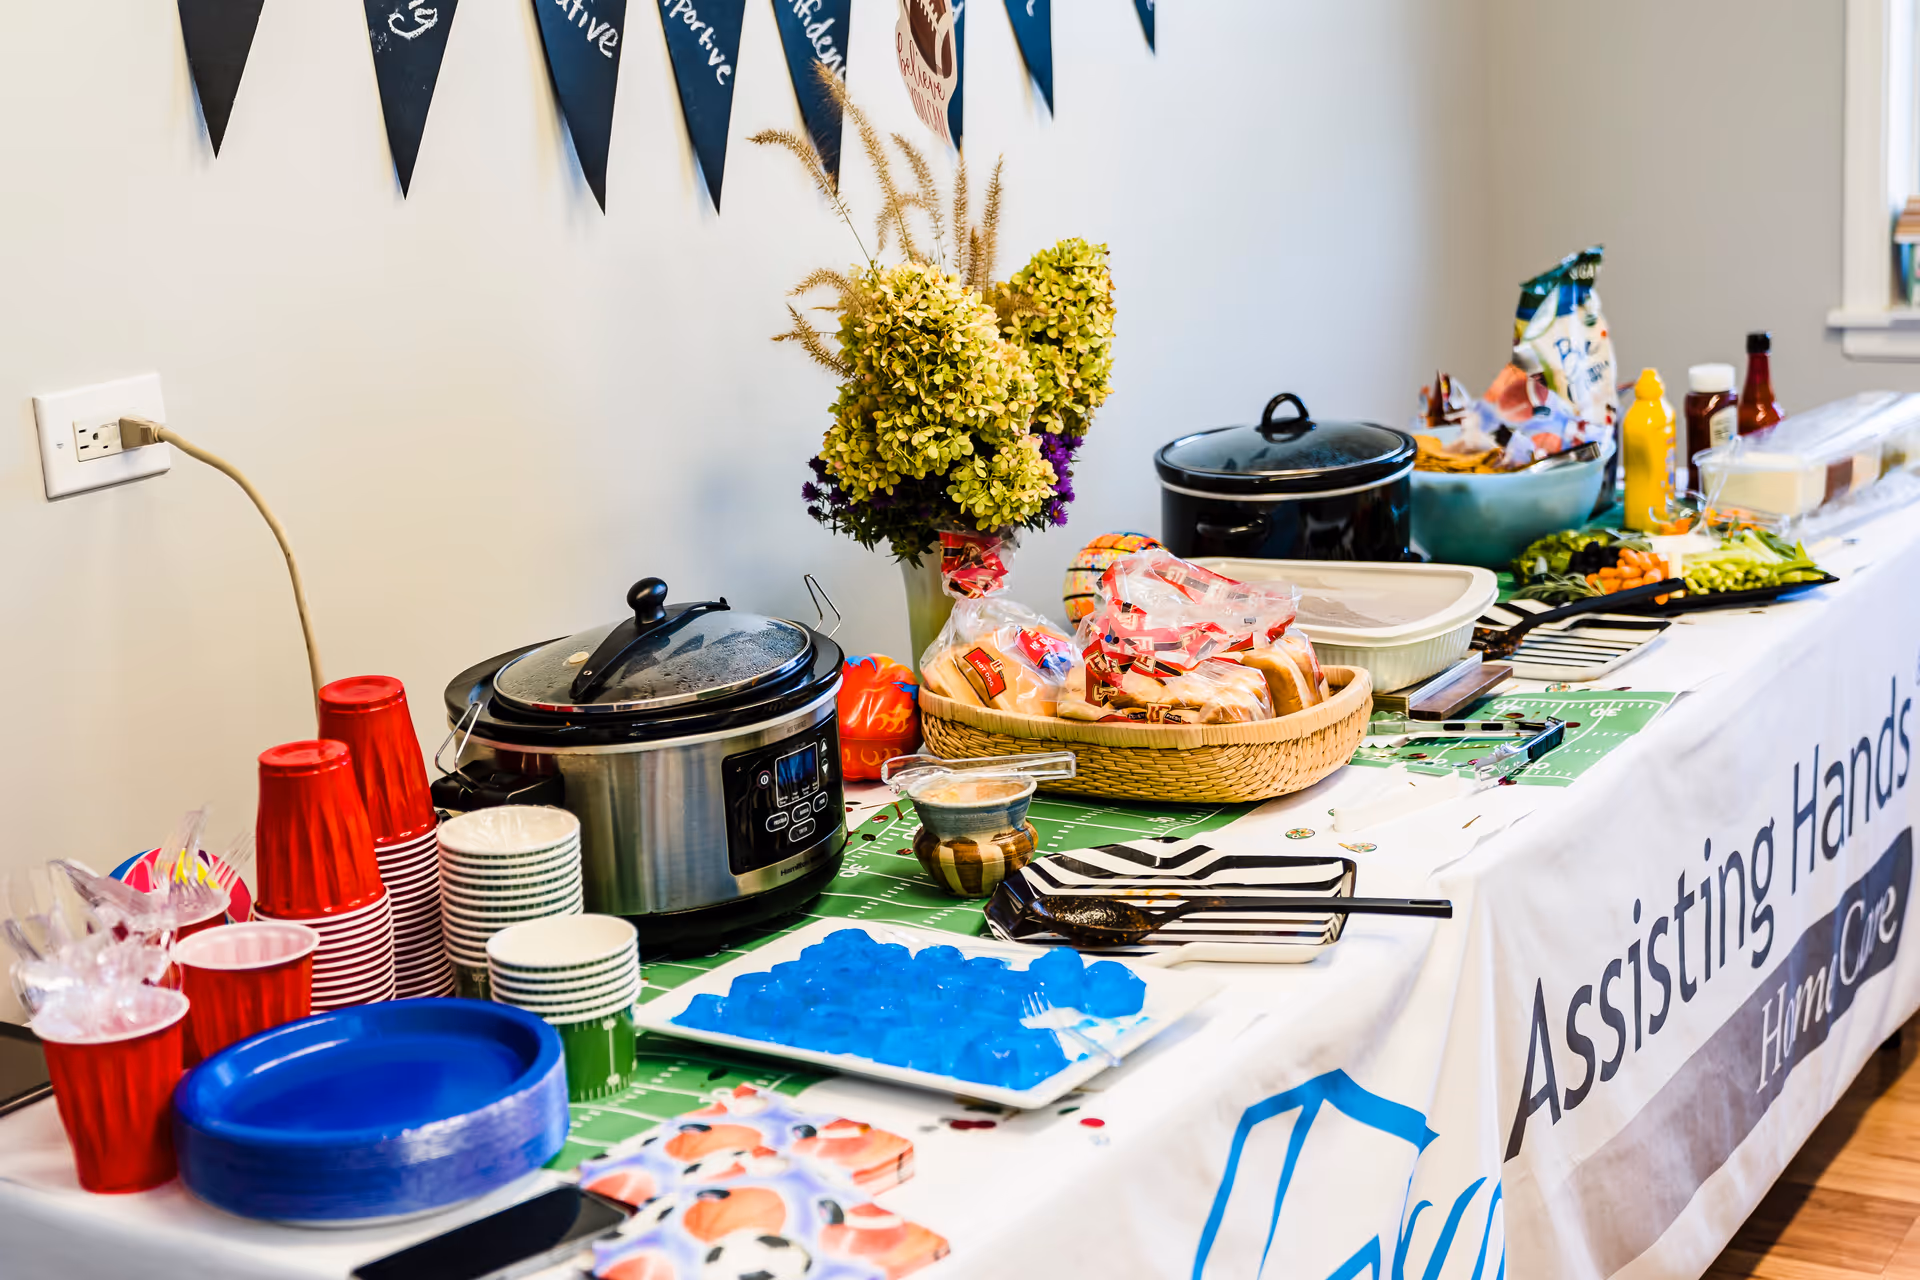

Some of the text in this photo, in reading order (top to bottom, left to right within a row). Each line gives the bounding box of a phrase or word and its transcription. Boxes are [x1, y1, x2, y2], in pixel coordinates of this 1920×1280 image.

[664, 0, 731, 85] portive
[975, 659, 994, 687] HOT DOG
[1503, 675, 1912, 1163] Assisting Hands
[1839, 885, 1897, 985] Care
